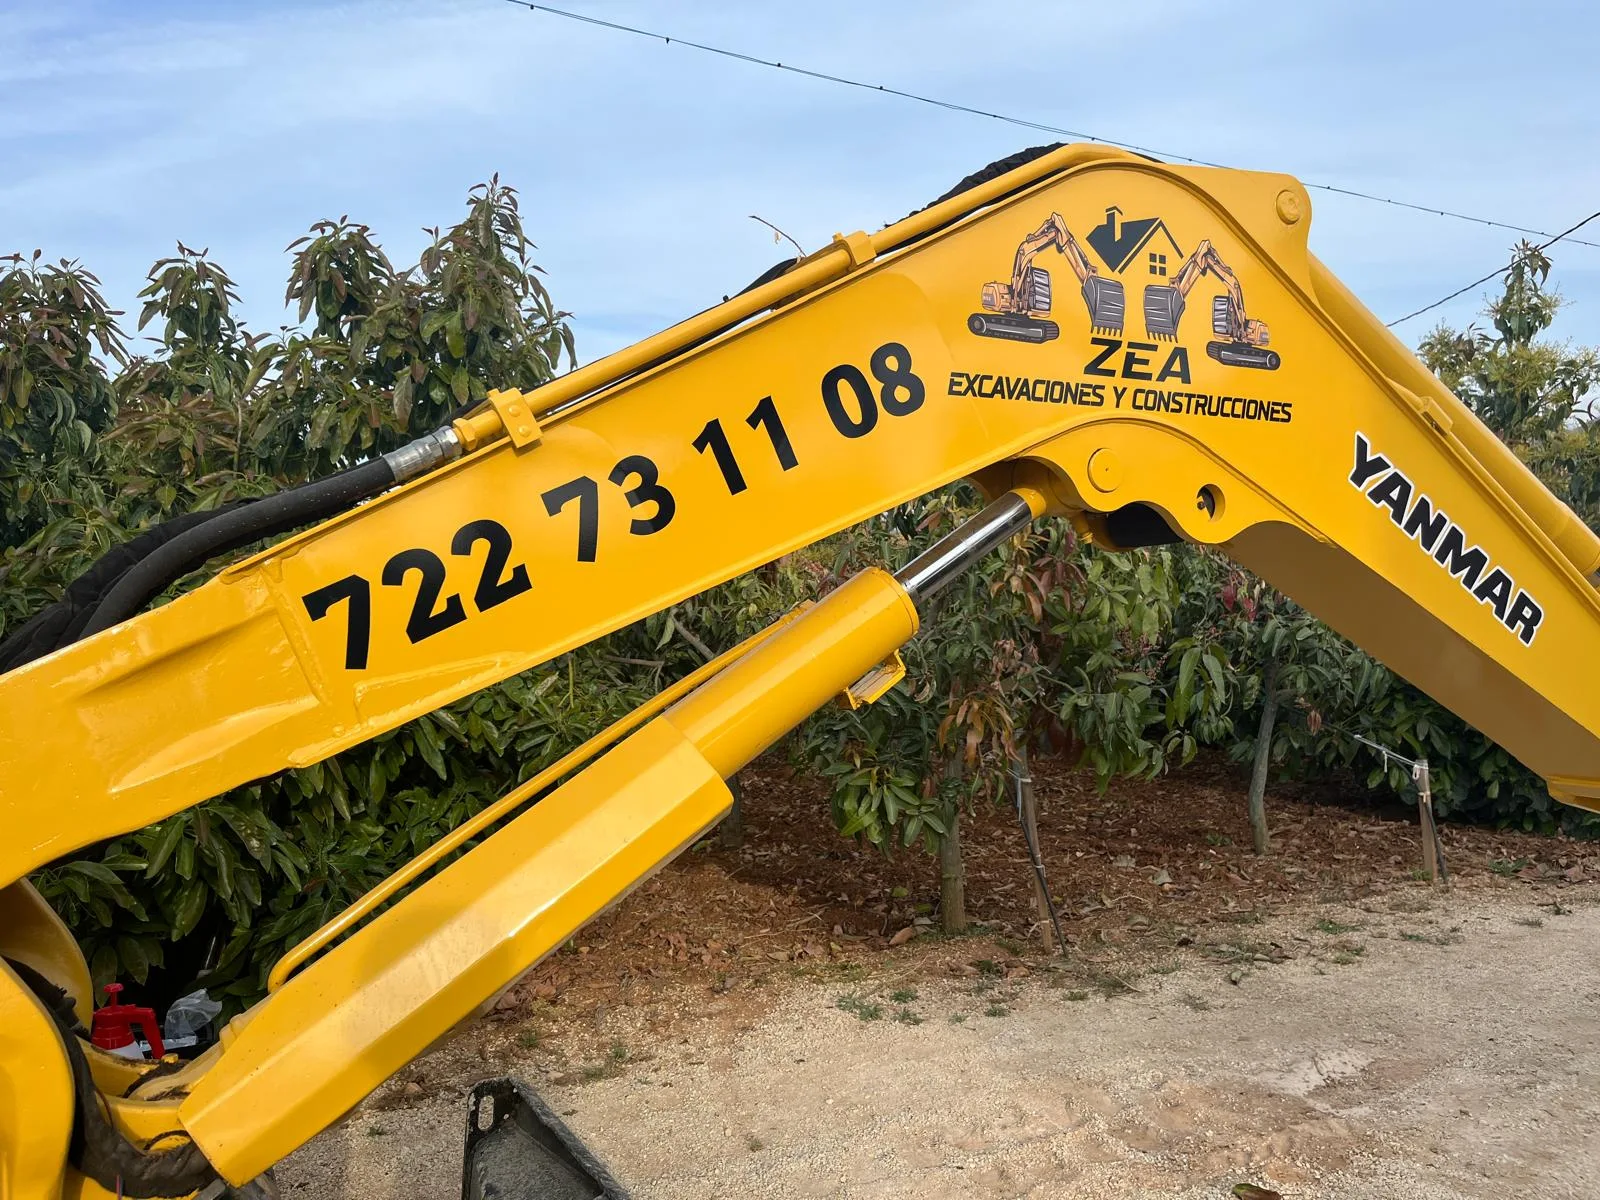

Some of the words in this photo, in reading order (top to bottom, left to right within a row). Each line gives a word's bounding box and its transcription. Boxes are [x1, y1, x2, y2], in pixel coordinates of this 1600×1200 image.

[948, 372, 1105, 407] EXCAVACIONES
[1113, 386, 1128, 409] Y
[1132, 389, 1293, 423] CONSTRUCCIONES
[1084, 338, 1191, 384] ZEA
[302, 519, 532, 670] 722
[541, 456, 676, 562] 73
[692, 396, 799, 496] 11
[822, 343, 926, 438] 08
[1349, 432, 1542, 646] YANMAR
